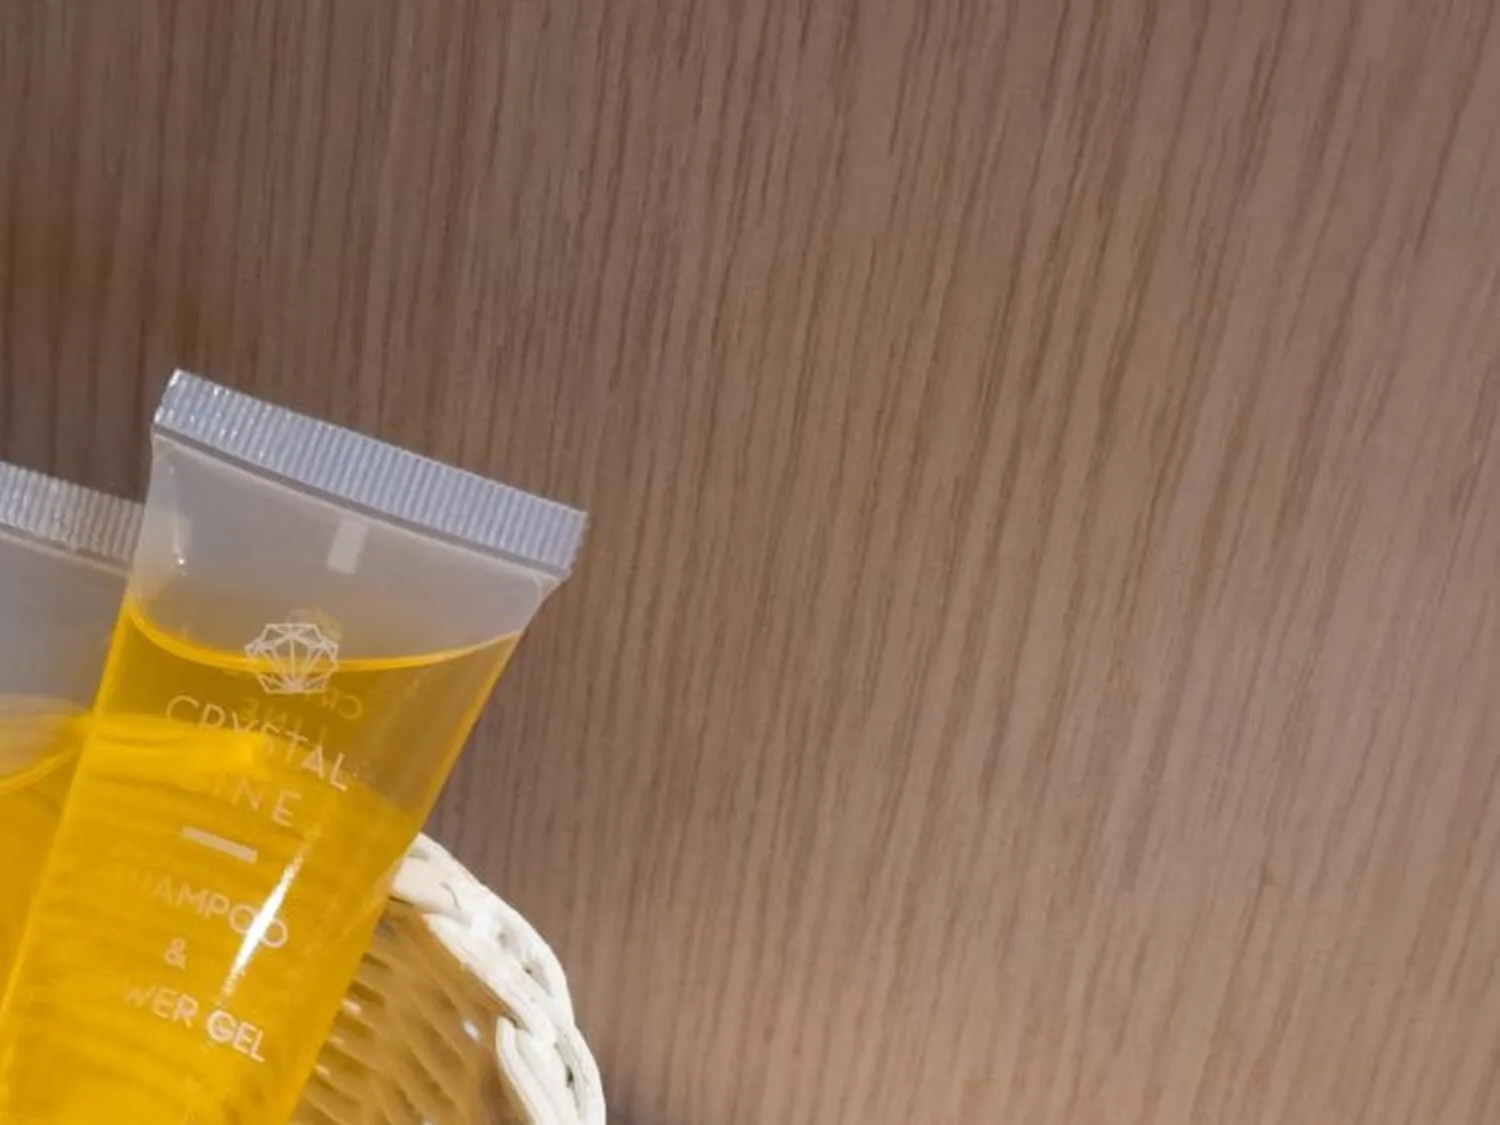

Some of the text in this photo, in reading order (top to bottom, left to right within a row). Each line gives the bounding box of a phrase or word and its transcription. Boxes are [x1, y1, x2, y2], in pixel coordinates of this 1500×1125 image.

[209, 774, 302, 828] INE
[164, 936, 187, 971] &
[206, 1009, 266, 1063] GEL
